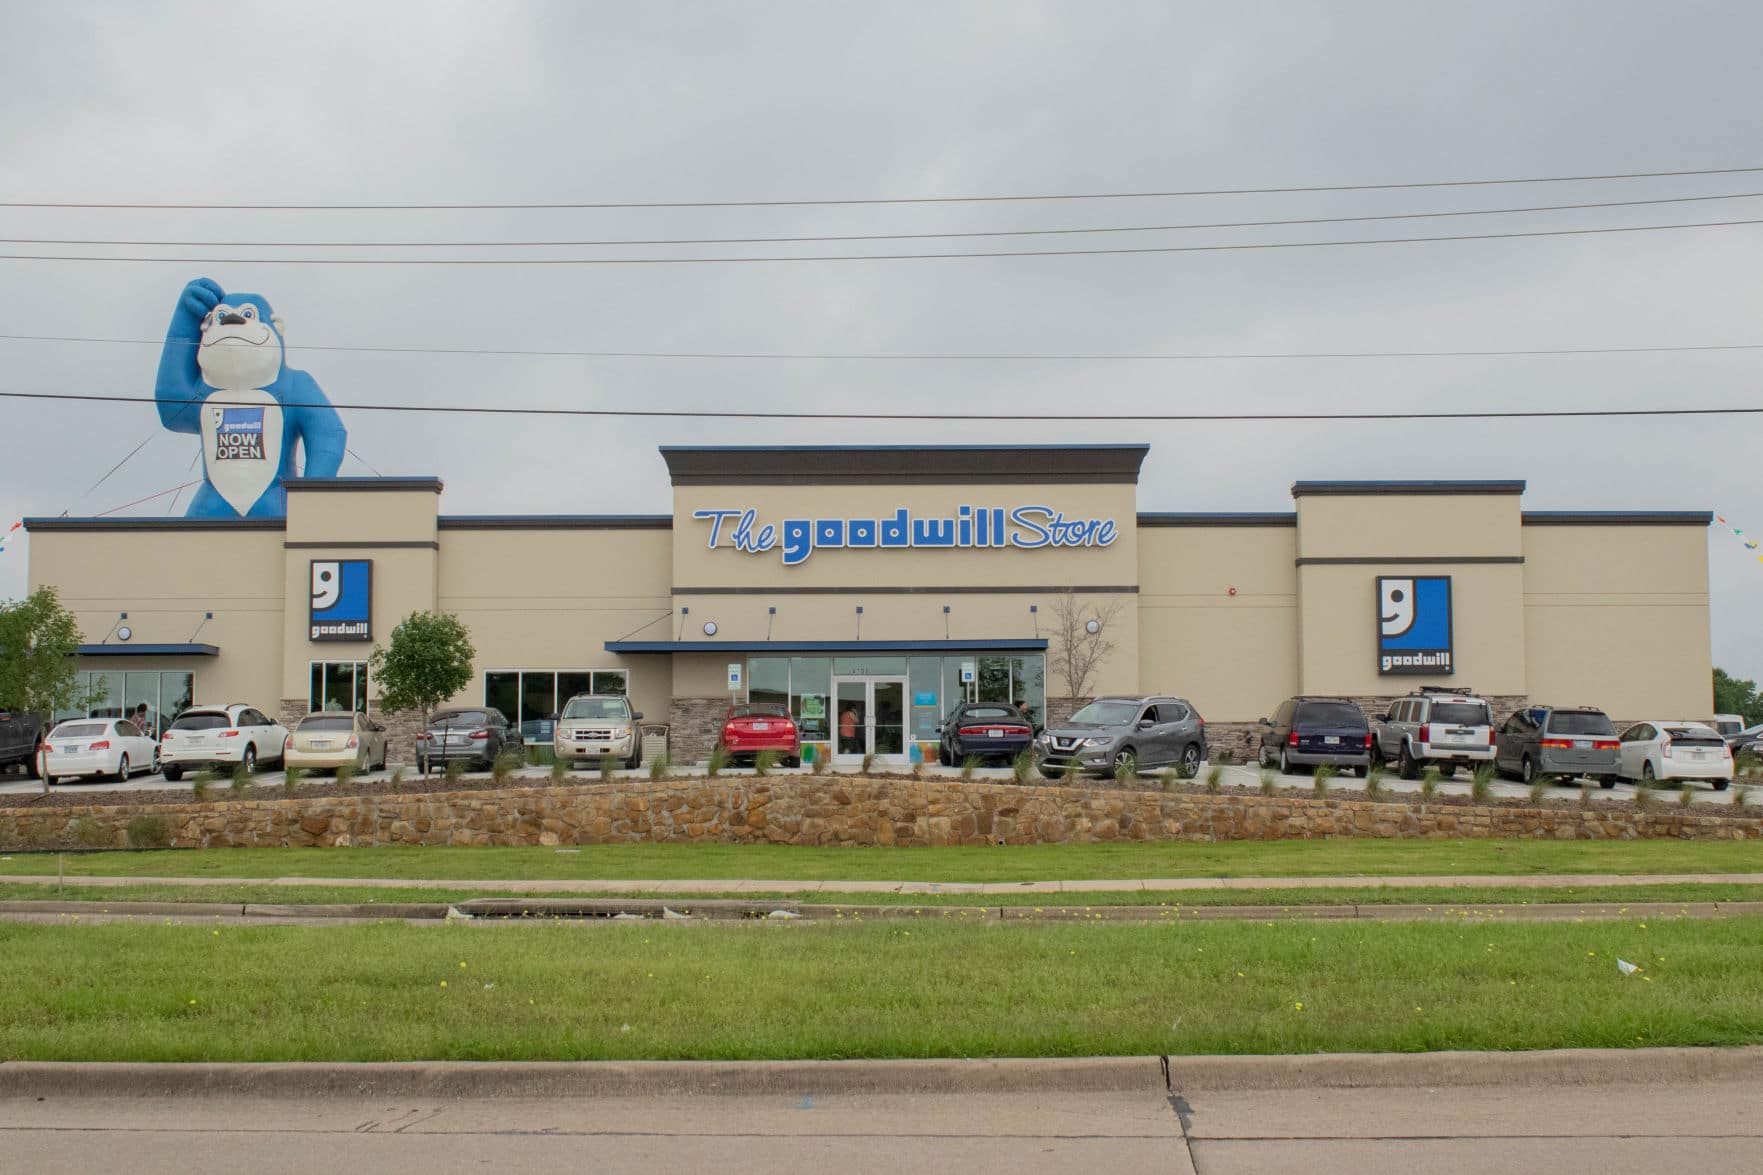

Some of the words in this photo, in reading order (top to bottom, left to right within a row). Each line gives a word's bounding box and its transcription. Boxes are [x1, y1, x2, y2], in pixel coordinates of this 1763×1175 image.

[224, 421, 262, 432] goodwill
[219, 433, 257, 446] NOW
[217, 446, 261, 459] OPEN
[693, 507, 777, 553] The
[782, 505, 1006, 565] goodwill
[1010, 505, 1119, 547] Store
[311, 622, 368, 638] goodwill
[1382, 652, 1450, 671] goodwill
